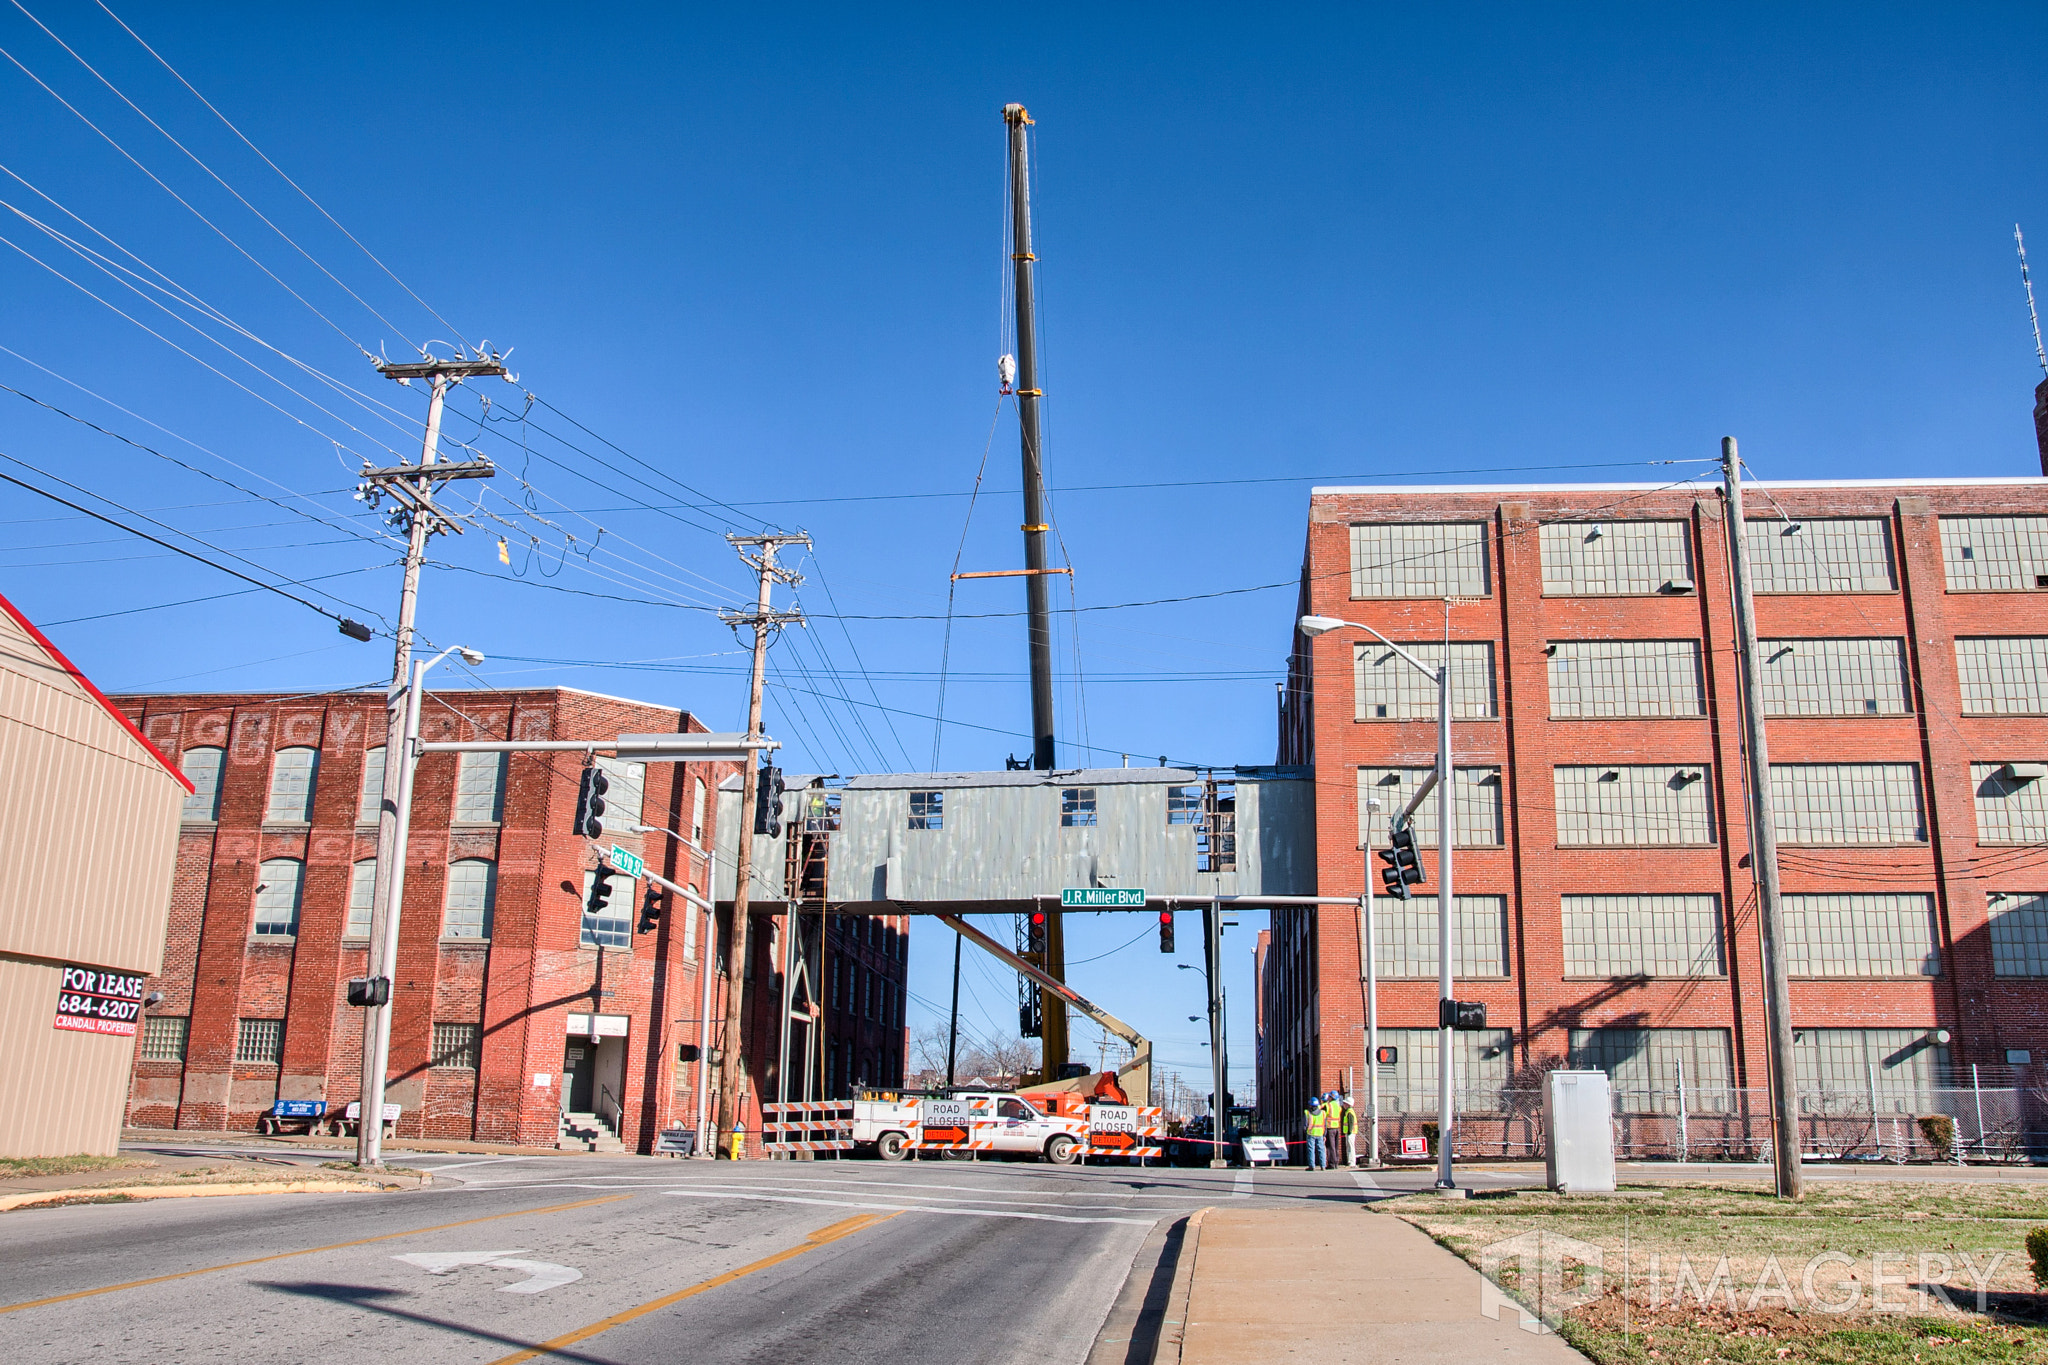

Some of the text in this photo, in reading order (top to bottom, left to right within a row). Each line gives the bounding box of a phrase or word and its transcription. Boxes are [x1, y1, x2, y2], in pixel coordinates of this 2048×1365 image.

[1118, 891, 1144, 904] Blvd.
[62, 967, 142, 998] FOR LEASE
[59, 994, 139, 1019] 684-6207
[55, 1015, 136, 1034] CRANDALL PROPERTIES
[933, 1104, 960, 1114] ROAD
[1100, 1109, 1128, 1120] ROAD
[927, 1116, 966, 1126] CLOSED
[1094, 1121, 1134, 1132] CLOSED
[1093, 1136, 1122, 1144] DETOUR
